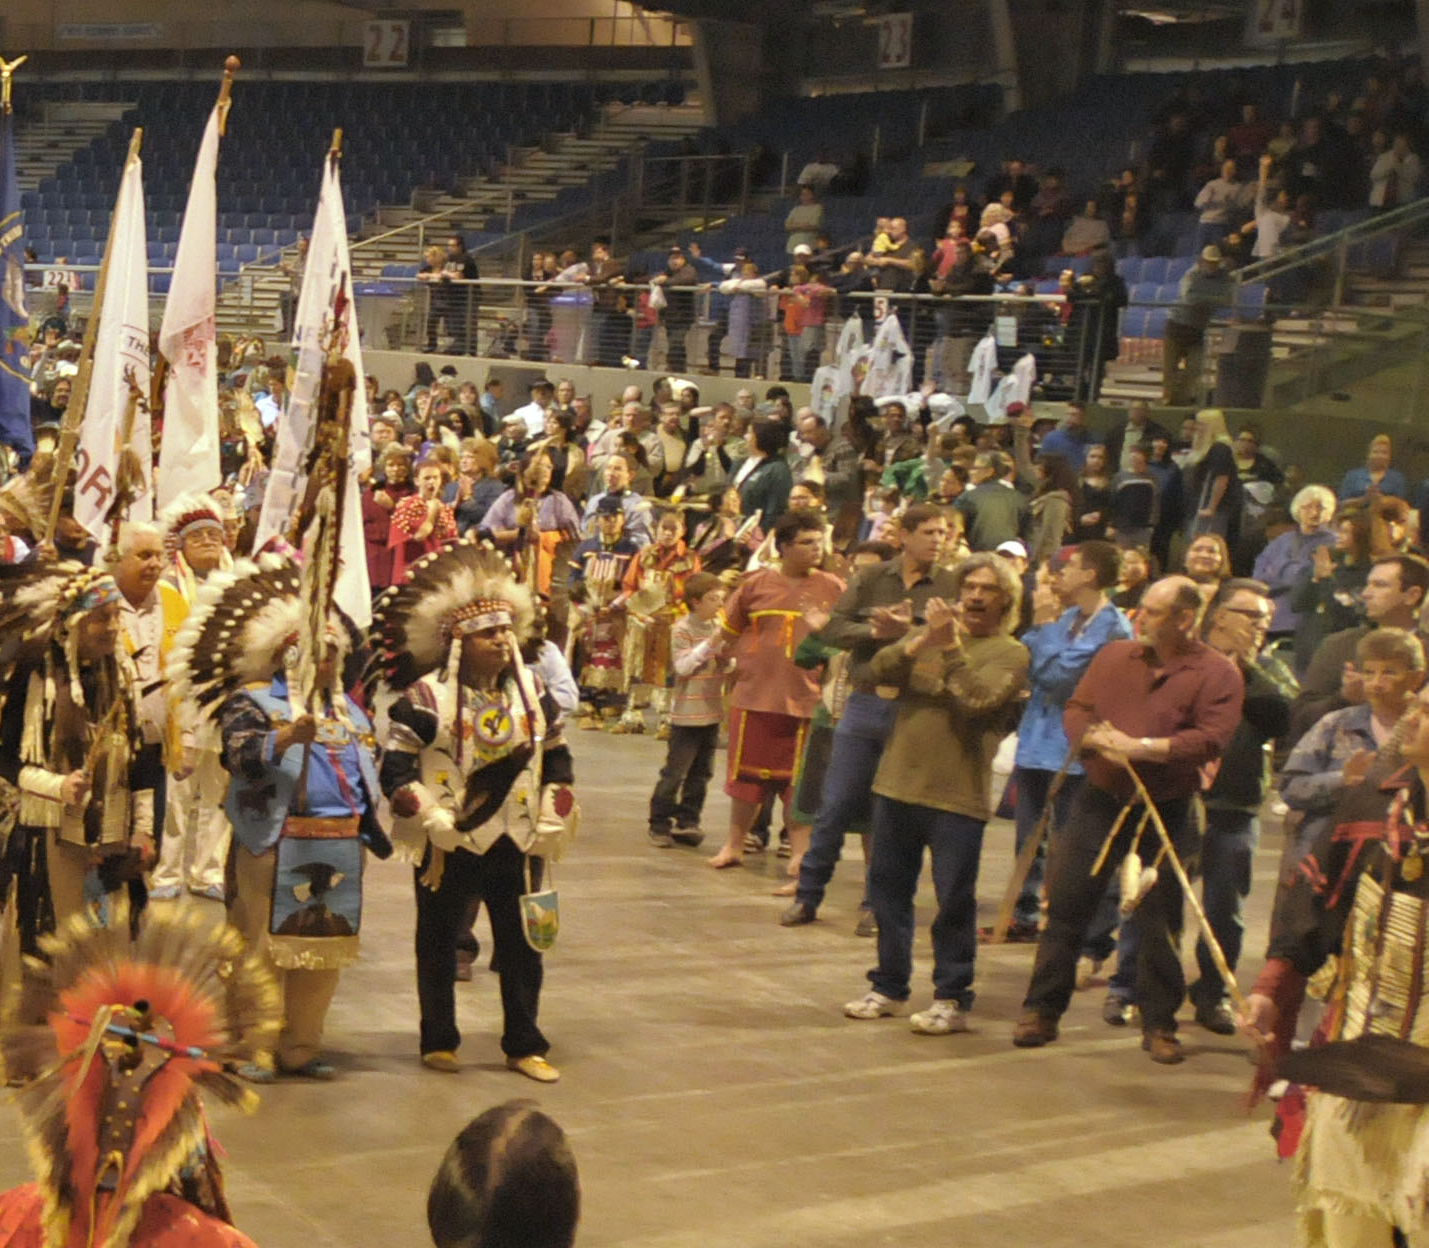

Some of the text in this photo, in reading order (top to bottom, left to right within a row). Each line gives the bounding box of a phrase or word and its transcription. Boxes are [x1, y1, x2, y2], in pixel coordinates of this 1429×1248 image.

[368, 25, 406, 62] 22
[882, 20, 909, 63] 23
[48, 271, 64, 286] 22
